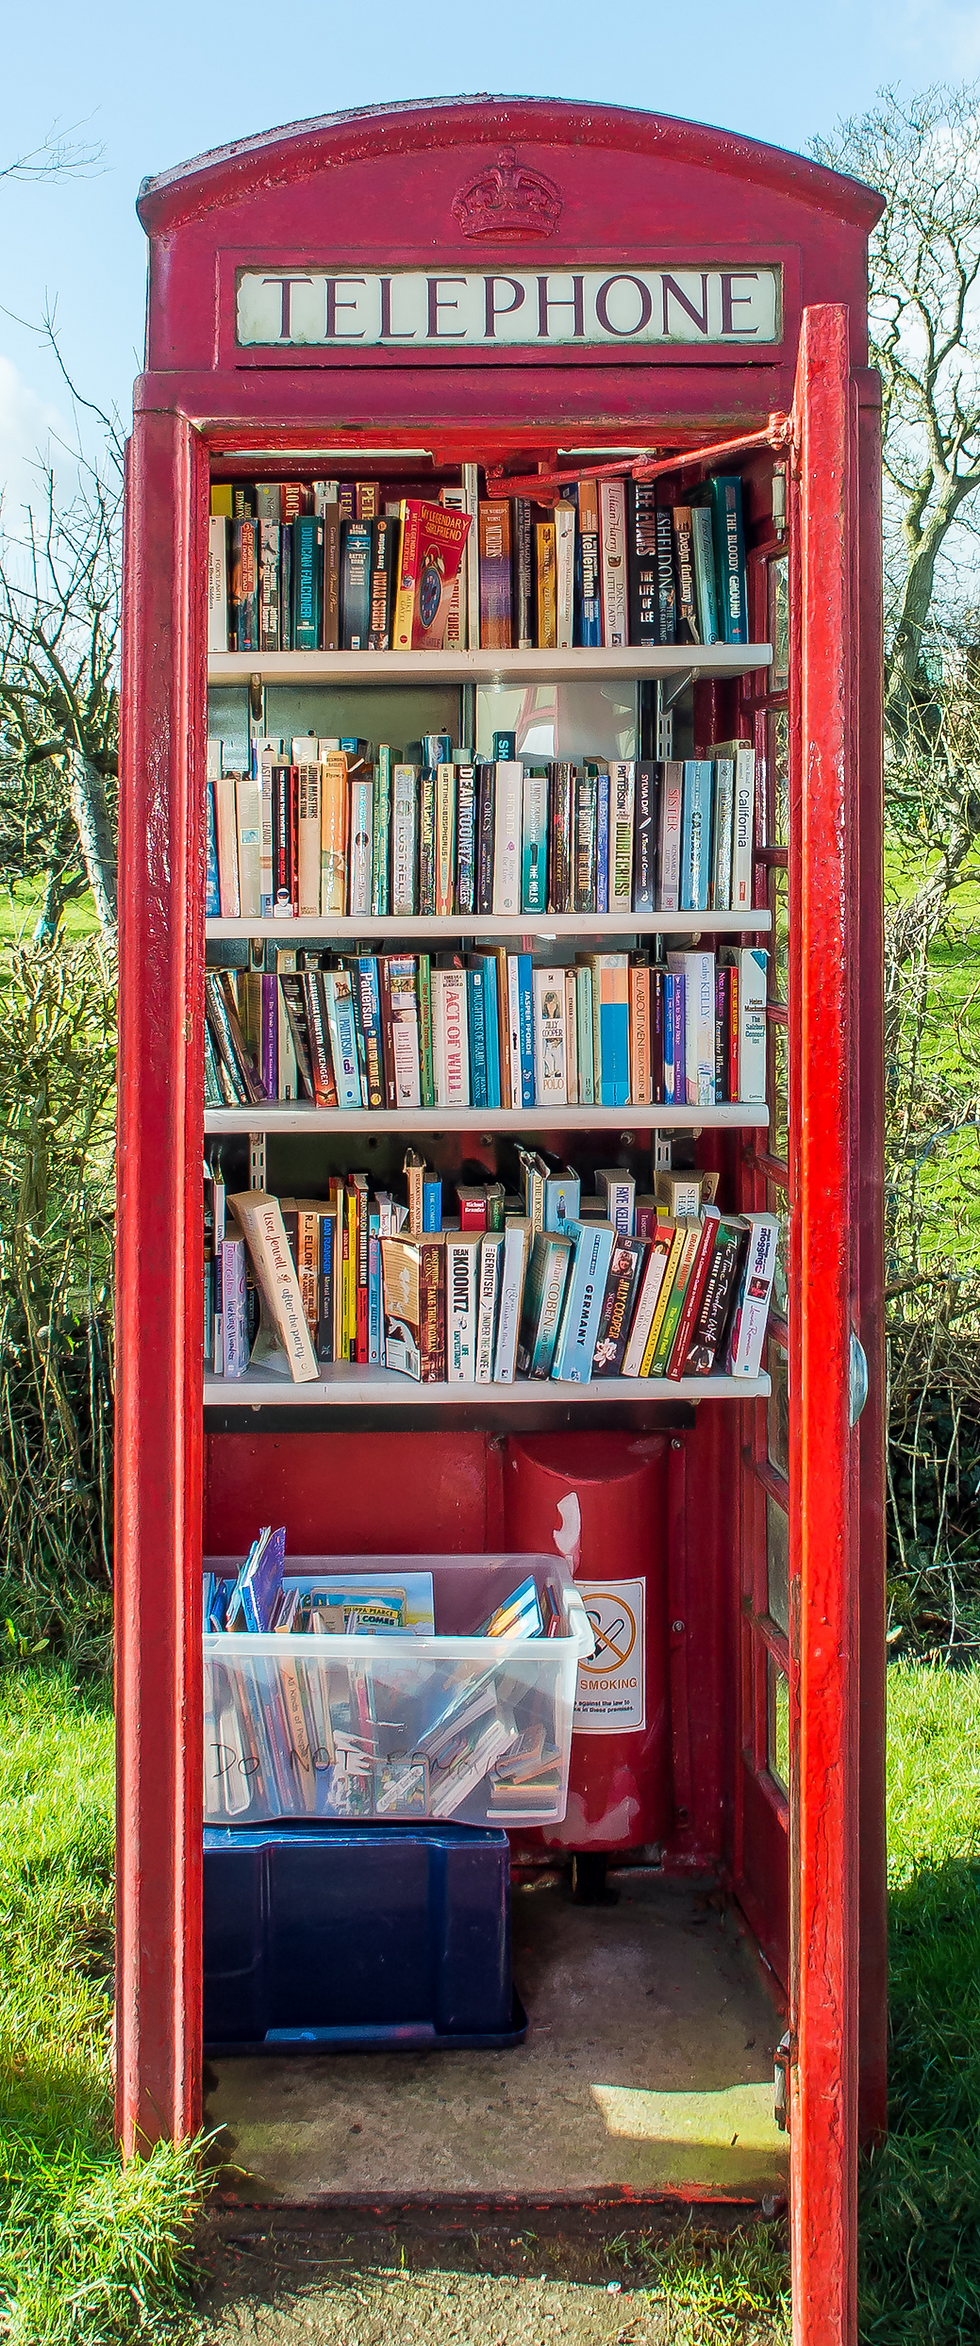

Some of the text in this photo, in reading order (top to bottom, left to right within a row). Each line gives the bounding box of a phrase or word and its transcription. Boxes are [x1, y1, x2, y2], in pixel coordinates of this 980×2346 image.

[262, 272, 759, 338] TELEPHONE
[635, 484, 655, 556] LEE EVANS
[727, 513, 736, 531] THE
[486, 525, 502, 558] MURDERS
[657, 518, 672, 589] SHELDON
[678, 532, 690, 562] Evelyn
[727, 535, 738, 572] BLOODY
[301, 527, 312, 617] DUNCAN FALCONER
[582, 534, 596, 598] kellerman
[640, 571, 654, 582] THE
[372, 572, 387, 631] CHRIS RYAN
[608, 572, 616, 630] LITTLE LADY
[616, 583, 624, 616] DANCE
[639, 585, 654, 596] LIFE
[642, 598, 652, 610] OF
[730, 575, 740, 619] GROUND
[640, 612, 655, 622] LEE
[262, 762, 271, 800] LAST NIGHT
[308, 766, 318, 819] JOHN MASTERS
[617, 765, 627, 810] PATTERSON
[459, 768, 473, 864] DEAN KOONTZ
[483, 801, 492, 832] ORCS
[578, 786, 591, 845] JOHN GRISHAM
[667, 789, 679, 833] SISTER
[737, 789, 750, 848] California
[529, 881, 538, 903] KILLS
[360, 973, 374, 1028] Patterson
[700, 956, 710, 1018] Cathy KELLY
[473, 989, 482, 1030] DAUGHTERS
[636, 971, 645, 1047] ALL ABOUT MEN
[339, 1019, 353, 1058] PATTERSON
[446, 991, 462, 1094] ACT OF WILL
[317, 1047, 328, 1085] AVENGER
[543, 1079, 564, 1090] POLO
[617, 1187, 628, 1204] FAYE
[305, 1215, 313, 1271] R.J. ELLORY
[323, 1219, 331, 1274] IAN RANKIN
[676, 1233, 698, 1291] GRAHAM HARVEY
[710, 1251, 722, 1277] AUDREY
[725, 1236, 738, 1256] The
[754, 1228, 767, 1264] snogging
[453, 1256, 469, 1313] KOONTZ
[483, 1253, 494, 1298] GERRITSEN
[543, 1251, 565, 1327] Harlan COBEN
[719, 1257, 734, 1280] Time
[282, 1288, 294, 1312] after
[288, 1314, 298, 1328] the
[427, 1286, 437, 1353] TAKE THIS WOMAN
[576, 1285, 593, 1347] GERMANY
[604, 1292, 615, 1321] SCORE!
[609, 1279, 630, 1339] JILLY COOPER
[481, 1337, 489, 1349] THE
[698, 1318, 718, 1343] Wife
[580, 1677, 638, 1690] SMOKING
[290, 1746, 358, 1772] NOT
